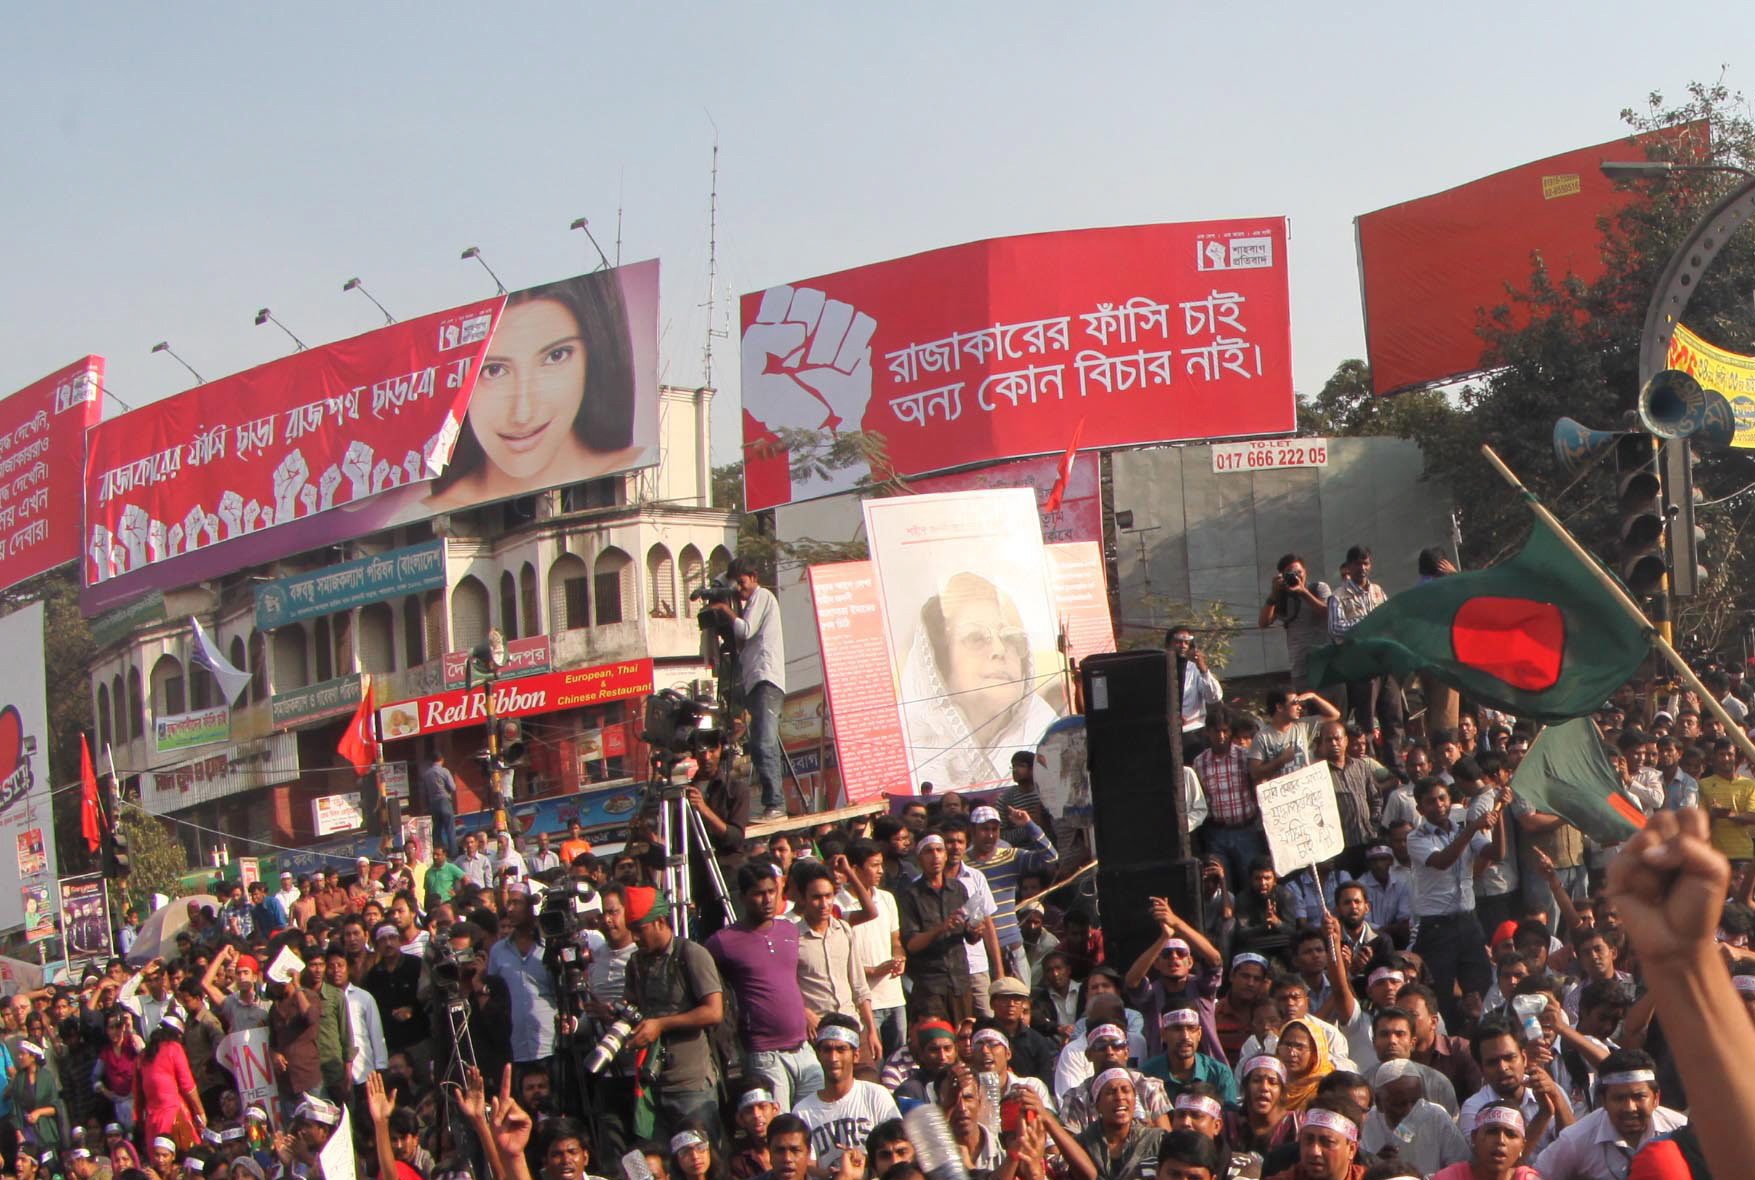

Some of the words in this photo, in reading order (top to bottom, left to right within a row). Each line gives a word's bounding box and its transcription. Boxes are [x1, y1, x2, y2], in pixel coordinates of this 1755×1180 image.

[1231, 244, 1266, 255] শাহবাগ
[1231, 254, 1267, 267] প্রতিবাদ
[884, 316, 1071, 385] রাজাকারের
[1079, 296, 1169, 347] ফাঁসি
[1178, 288, 1247, 336] চাই
[888, 380, 966, 428] অন্য
[977, 362, 1066, 413] কোন
[1073, 348, 1172, 398] বিচার
[1180, 334, 1264, 381] নাই।
[98, 443, 187, 509] রাজাকারের
[186, 423, 233, 467] ফাঁসি
[236, 413, 281, 463] ছাড়া
[284, 386, 368, 446] রাজপথ
[372, 365, 441, 421] ছাড়বো
[446, 355, 478, 389] না
[1249, 440, 1292, 449] TO-LET
[1216, 452, 1243, 470] 017
[1247, 449, 1274, 468] 666
[1278, 447, 1305, 466] 222
[1308, 447, 1327, 464] 05
[315, 567, 365, 596] সমাজকল্যাণ
[365, 556, 395, 583] পরিষদ
[564, 670, 615, 686] European,
[616, 663, 639, 676] Thai
[600, 680, 607, 688] &
[424, 695, 468, 729] Red
[471, 683, 546, 720] Ribbon
[557, 690, 598, 707] Chinese
[598, 681, 653, 700] Restaurant
